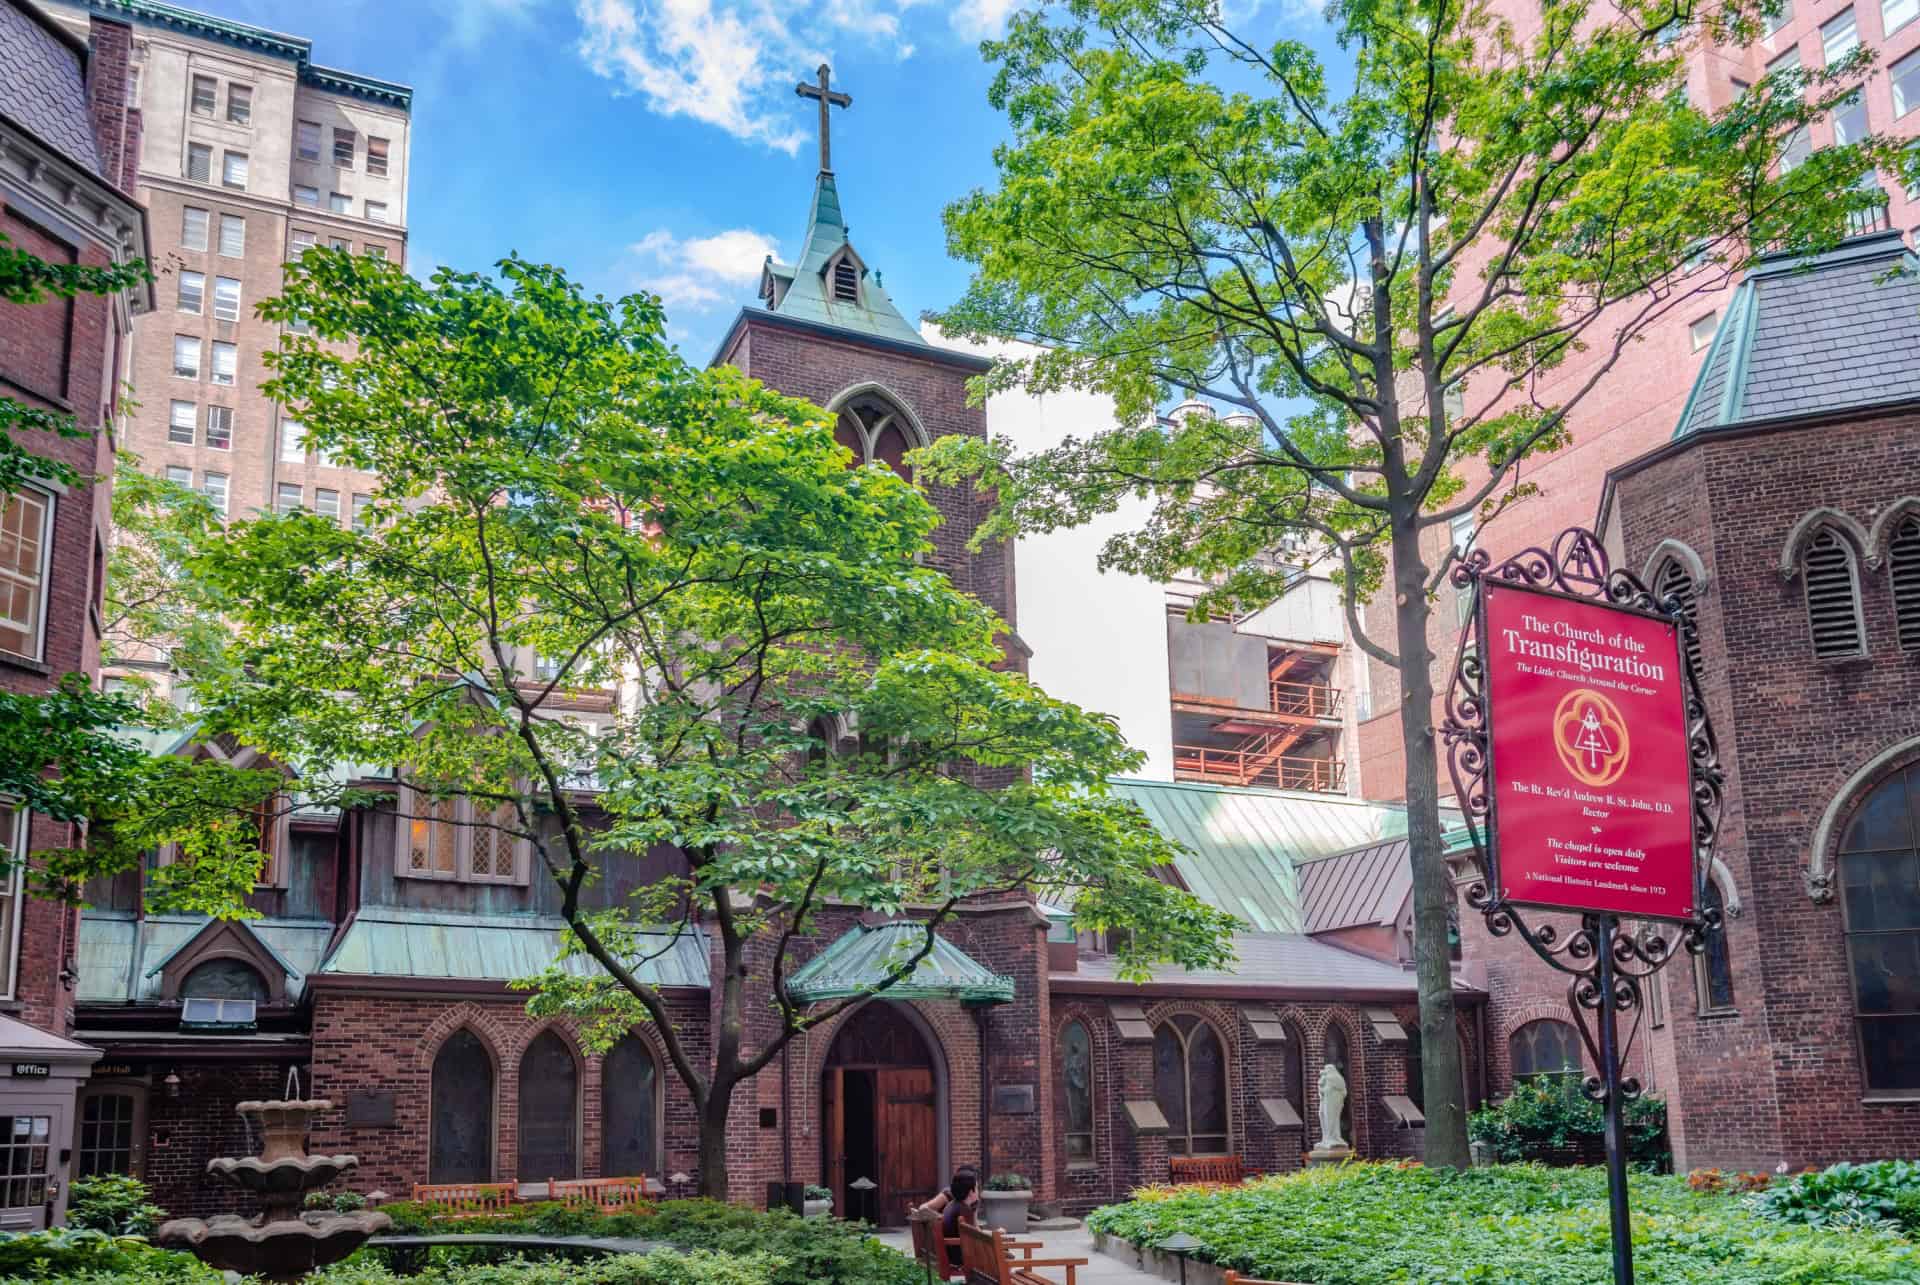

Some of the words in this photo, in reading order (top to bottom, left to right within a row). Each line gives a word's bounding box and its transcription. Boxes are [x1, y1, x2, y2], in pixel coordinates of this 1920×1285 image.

[1522, 615, 1550, 633] The
[1554, 621, 1604, 645] Church
[1609, 634, 1622, 648] of
[1624, 637, 1645, 653] the
[1503, 629, 1664, 681] Transfiguration
[1516, 661, 1532, 673] The
[1533, 664, 1554, 677] Little
[1556, 670, 1586, 683] Church
[1587, 676, 1616, 689] Around
[1617, 681, 1629, 691] the
[1631, 683, 1657, 696] Corner
[1512, 780, 1529, 793] The
[1573, 789, 1604, 804] Andrew
[1617, 795, 1629, 808] St.
[1583, 806, 1610, 818] Rector
[1547, 837, 1563, 849] The
[1564, 840, 1593, 853] chapel
[1594, 843, 1602, 854] is
[1603, 848, 1624, 857] open
[1624, 848, 1646, 861] daily
[1554, 853, 1587, 867] Visitors
[1588, 860, 1602, 869] are
[1604, 861, 1639, 873] welcome
[1525, 871, 1531, 881] A
[1532, 871, 1563, 884] National
[1564, 874, 1593, 887] Historic
[1594, 879, 1629, 892] Landmark
[1630, 884, 1648, 894] since
[17, 1064, 48, 1075] Office
